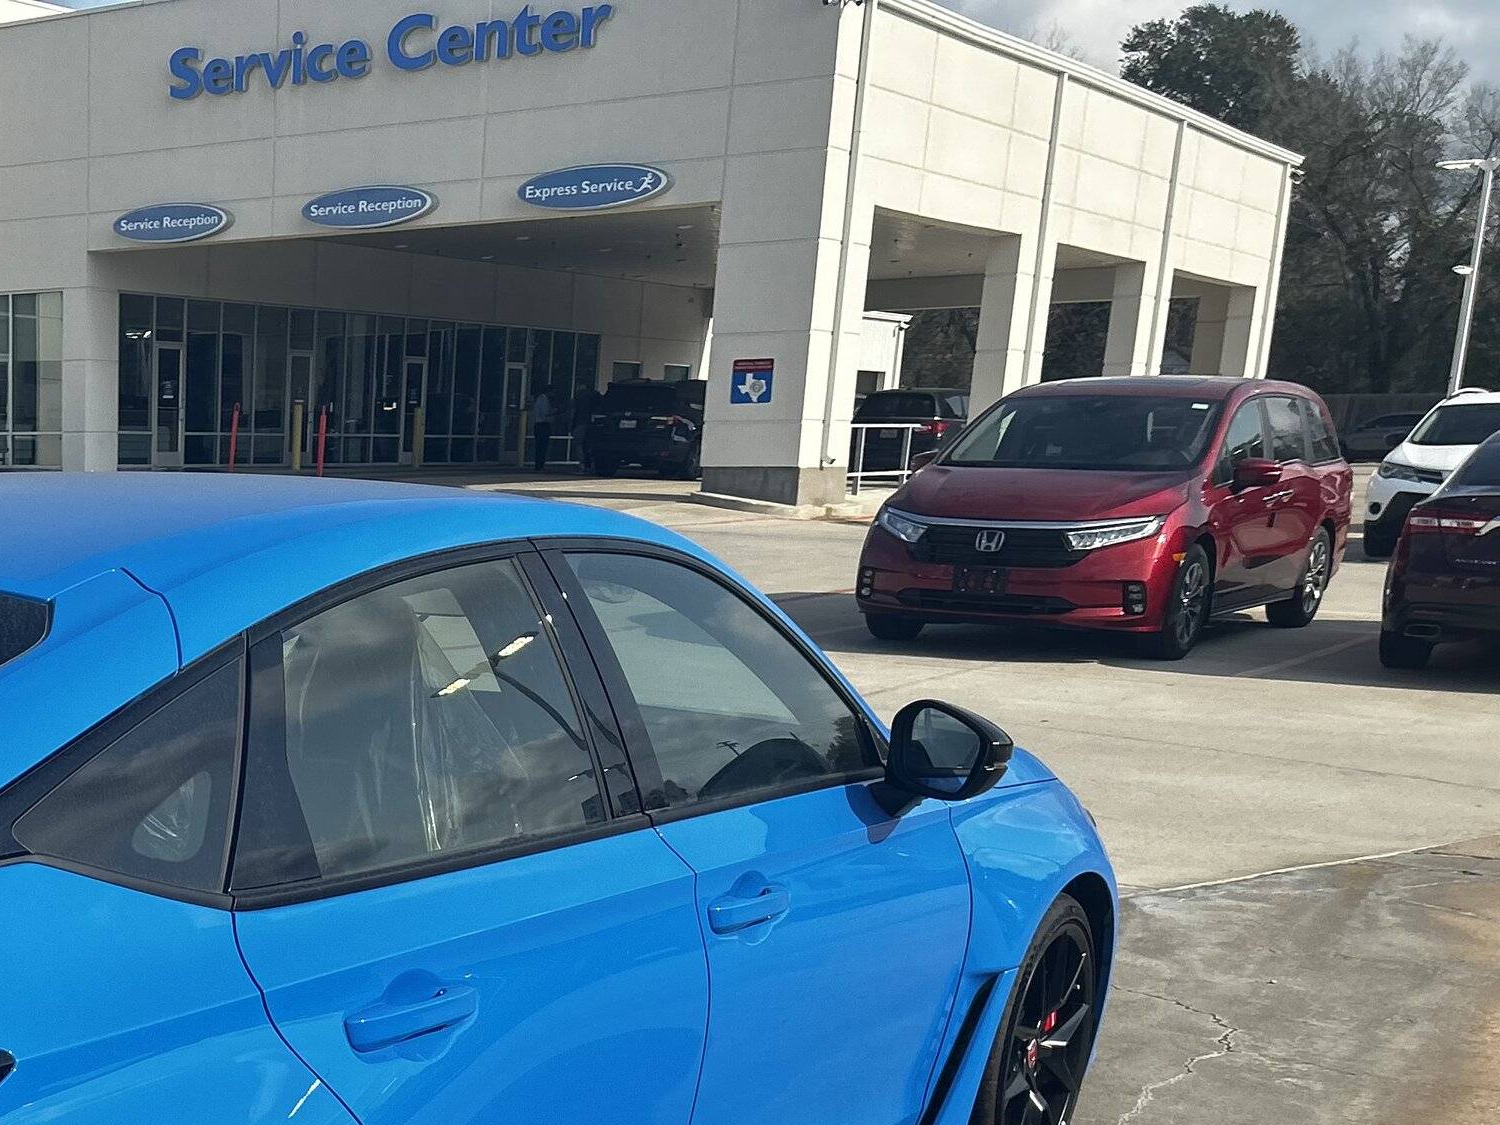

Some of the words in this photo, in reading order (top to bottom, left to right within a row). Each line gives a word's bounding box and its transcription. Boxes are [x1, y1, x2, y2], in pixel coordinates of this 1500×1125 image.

[169, 31, 373, 100] Service
[387, 4, 614, 71] Center
[525, 184, 578, 201] Express
[581, 179, 634, 194] Service
[310, 202, 356, 217] Service
[358, 197, 421, 213] Reception
[120, 218, 160, 231] Service
[163, 214, 218, 229] Reception
